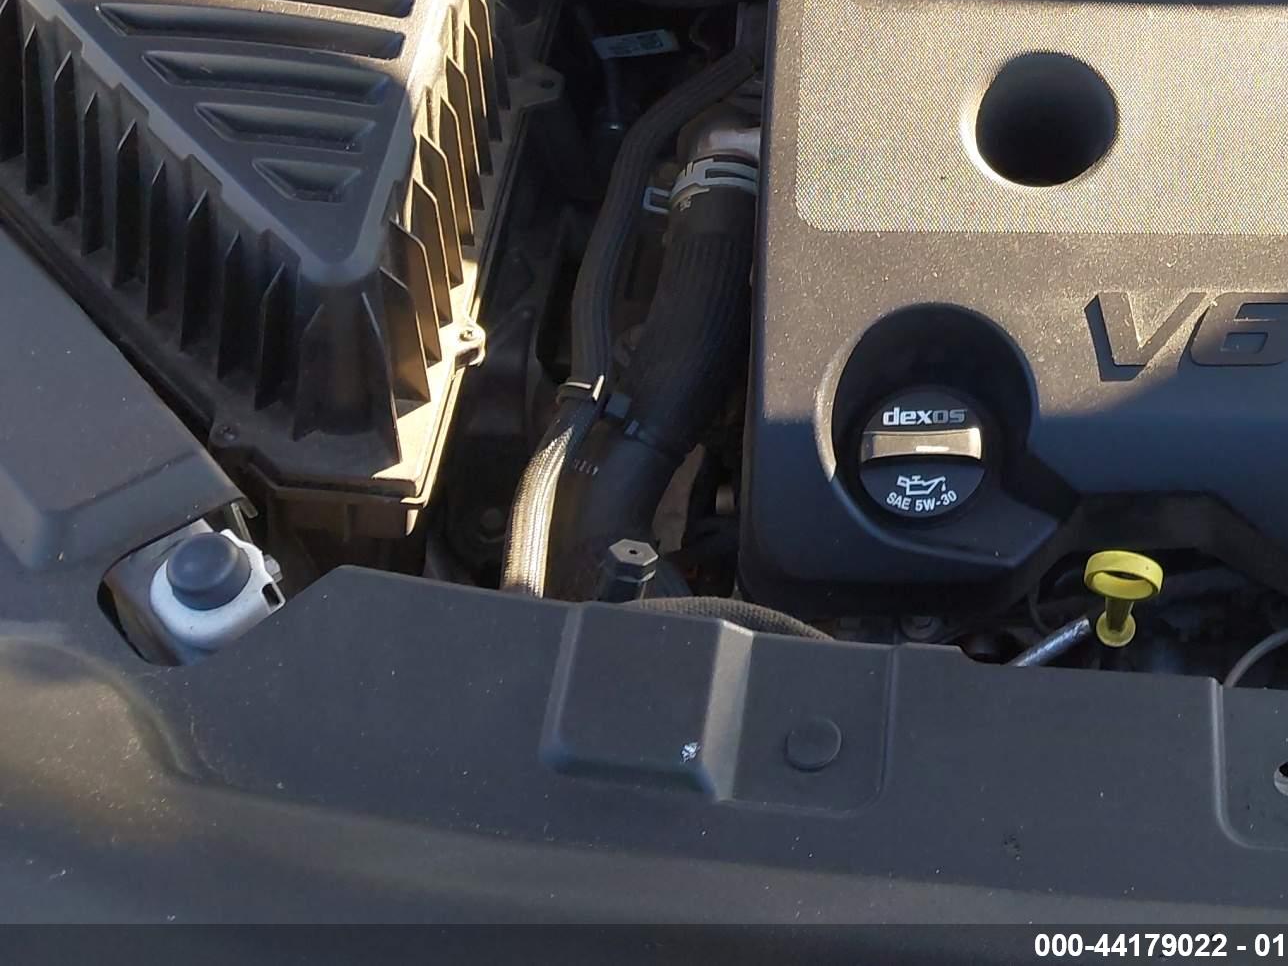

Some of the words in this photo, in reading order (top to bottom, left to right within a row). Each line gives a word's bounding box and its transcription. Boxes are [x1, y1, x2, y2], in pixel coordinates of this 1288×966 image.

[882, 407, 968, 426] dexos
[886, 491, 912, 512] SAE
[915, 489, 958, 512] 5W-30
